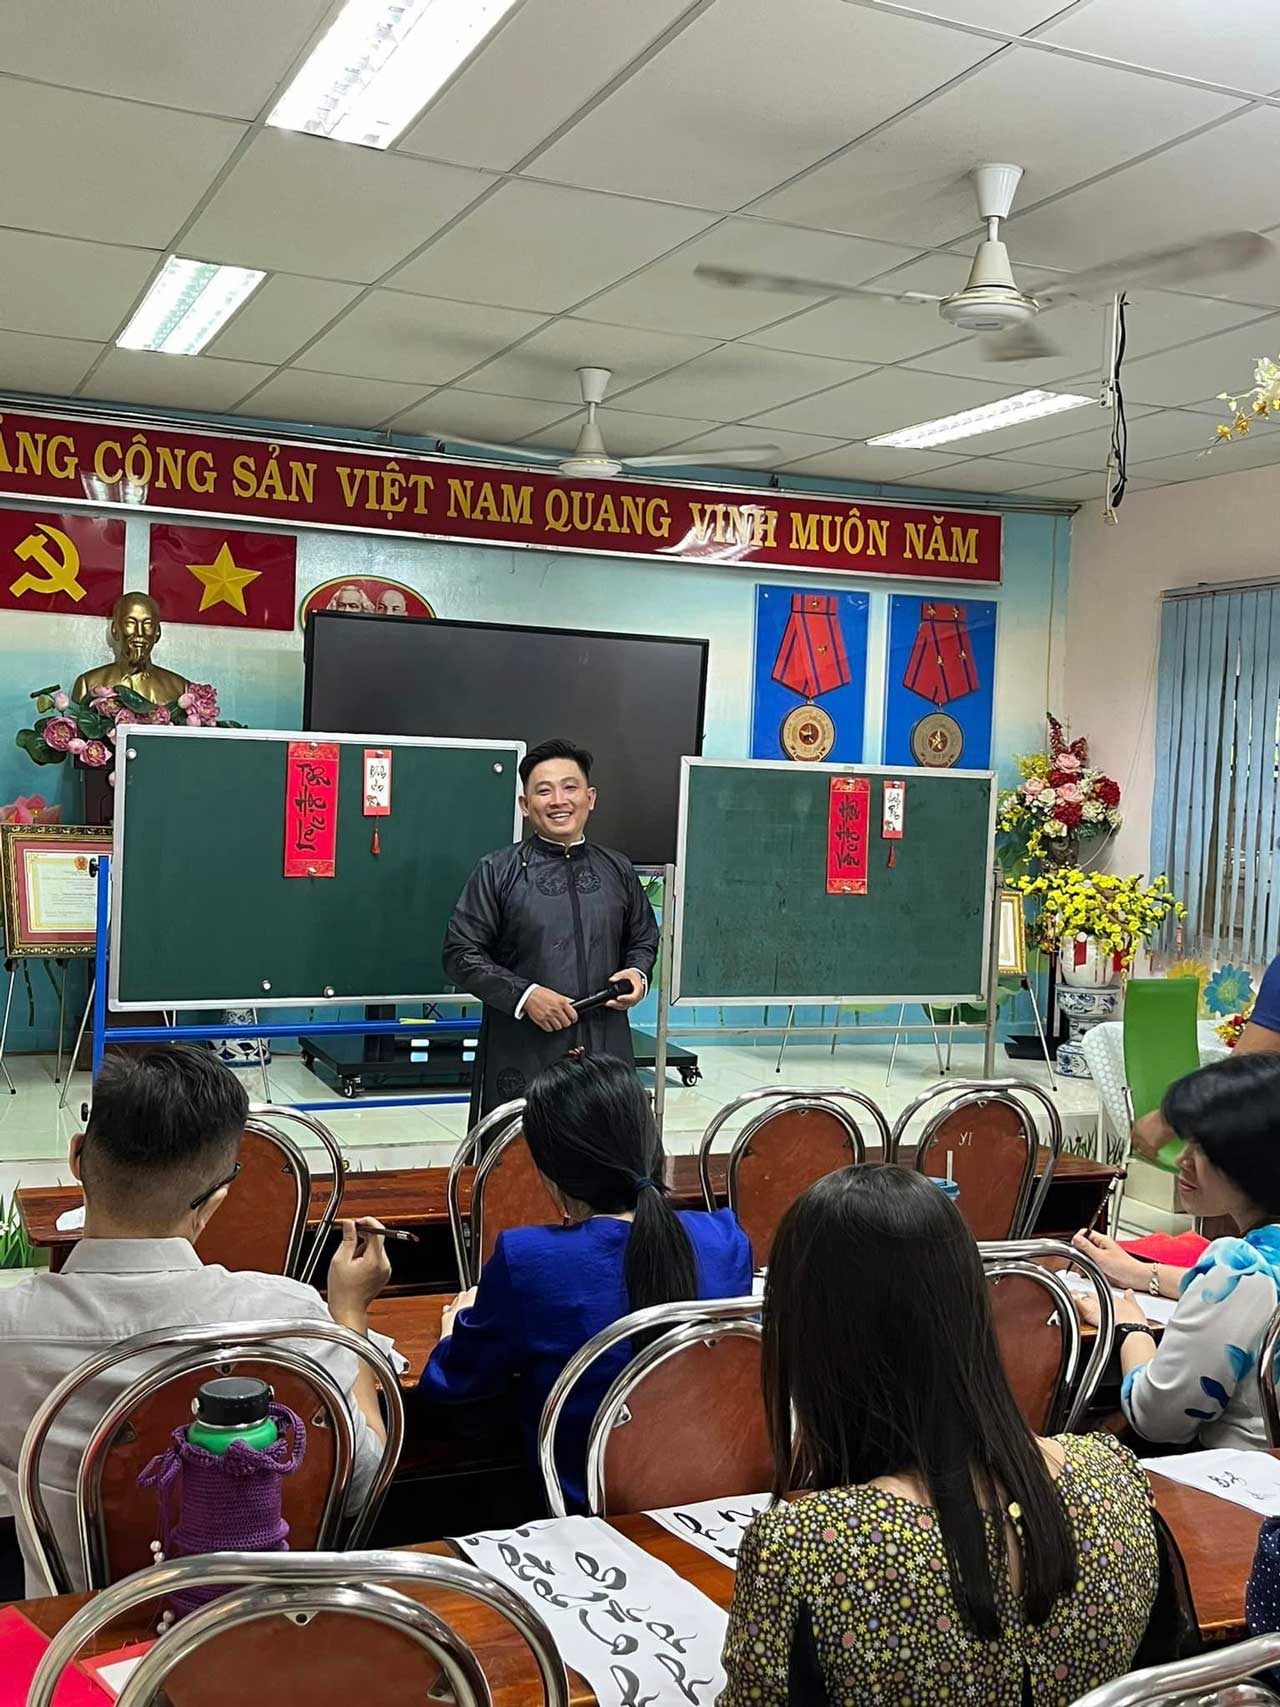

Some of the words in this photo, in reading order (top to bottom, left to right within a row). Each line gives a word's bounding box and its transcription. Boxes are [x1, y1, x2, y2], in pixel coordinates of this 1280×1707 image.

[94, 433, 217, 497] CỘNG
[232, 444, 318, 503] SẢN
[336, 461, 435, 520] VIỆT
[447, 478, 534, 525] NAM
[545, 488, 672, 538] QUANG
[688, 502, 778, 548] VINH
[789, 507, 890, 556] MUÔN
[903, 515, 979, 564] NĂM
